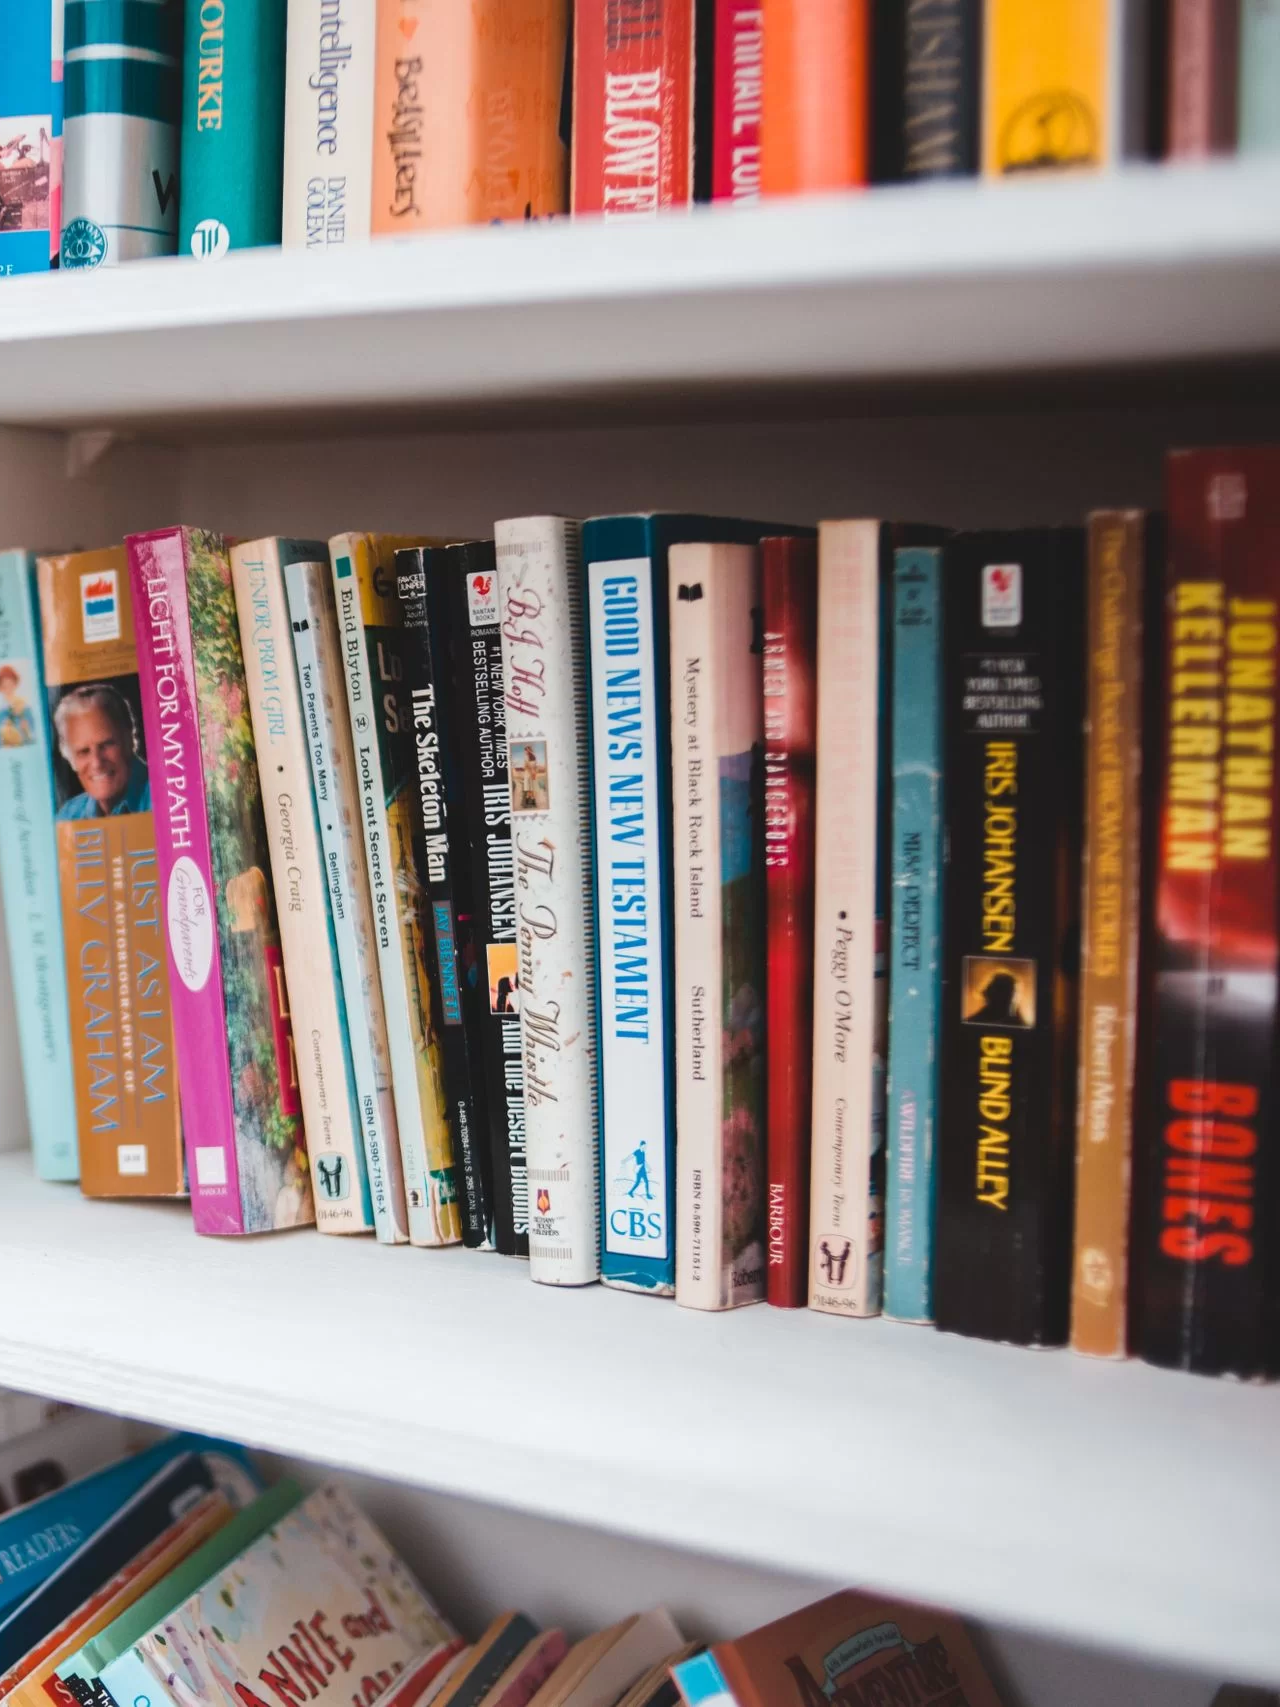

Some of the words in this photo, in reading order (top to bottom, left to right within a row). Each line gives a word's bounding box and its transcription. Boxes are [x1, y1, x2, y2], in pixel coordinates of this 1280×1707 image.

[604, 67, 661, 178] BLOW
[146, 576, 172, 653] LIGHT
[241, 557, 271, 646] JUNIOR
[472, 607, 496, 616] BANTAM
[474, 614, 495, 623] BOOKS
[601, 575, 640, 657] GOOD
[259, 637, 279, 691] PROM
[302, 664, 313, 689] Two
[340, 587, 358, 635] Enid
[350, 637, 364, 703] Blyton
[763, 631, 787, 698] ARMED
[154, 664, 181, 719] FOR
[411, 684, 435, 731] The
[472, 640, 492, 725] BESTSELLING
[491, 662, 506, 694] NEW
[504, 653, 548, 720] Hoff
[683, 656, 702, 728] Mystery
[263, 692, 287, 746] GIRL
[308, 692, 320, 740] Parents
[492, 695, 508, 735] YORK
[605, 666, 644, 762] NEWS
[687, 733, 702, 753] at
[764, 709, 787, 741] AND
[1166, 580, 1224, 872] KELLERMAN
[1220, 597, 1279, 860] JONATHAN
[160, 721, 184, 771] MY
[313, 743, 323, 767] Too
[359, 746, 374, 792] Look
[478, 726, 495, 779] AUTHOR
[494, 733, 510, 769] TIMES
[983, 742, 1018, 797] IRIS
[317, 768, 329, 802] Many
[365, 795, 378, 827] out
[417, 732, 447, 830] Skeleton
[608, 774, 646, 849] NEW
[688, 758, 704, 809] Black
[764, 751, 789, 867] DANGEROUS
[165, 776, 192, 850] PATH
[277, 792, 296, 861] Georgia
[688, 814, 704, 860] Rock
[73, 827, 108, 928] BILLY
[111, 855, 123, 891] THE
[286, 865, 303, 913] Craig
[327, 851, 345, 920] Bellingham
[368, 830, 385, 889] Secret
[425, 831, 451, 884] Man
[515, 830, 557, 890] The
[982, 800, 1018, 953] JOHANSEN
[127, 847, 161, 937] JUST
[173, 866, 198, 981] Grandparents
[192, 886, 206, 918] FOR
[373, 894, 389, 950] Seven
[432, 906, 450, 935] JAY
[689, 865, 705, 920] Island
[517, 902, 558, 994] Penny
[610, 858, 650, 1045] TESTAMENT
[831, 925, 854, 984] Peggy
[901, 885, 923, 972] PERFECT
[114, 900, 134, 1062] AUTOBIOGRAPHY
[135, 949, 164, 999] AS
[437, 936, 461, 1021] BENNETT
[79, 939, 121, 1134] GRAHAM
[138, 1008, 163, 1022] I
[691, 984, 706, 1082] Sutherland
[832, 989, 854, 1064] O'More
[124, 1069, 136, 1094] OF
[140, 1031, 168, 1105] AM
[523, 998, 562, 1108] Whistle
[978, 1035, 1013, 1123] BLIND
[311, 1028, 330, 1112] Contemporary
[321, 1114, 333, 1147] Teens
[364, 1094, 375, 1125] ISBN
[692, 1169, 702, 1200] ISBN
[976, 1125, 1010, 1212] ALLEY
[1159, 1077, 1259, 1267] BONES
[609, 1207, 662, 1242] CBS
[768, 1183, 786, 1266] BARBOUR
[233, 1609, 356, 1707] ANNIE
[339, 1586, 395, 1640] and
